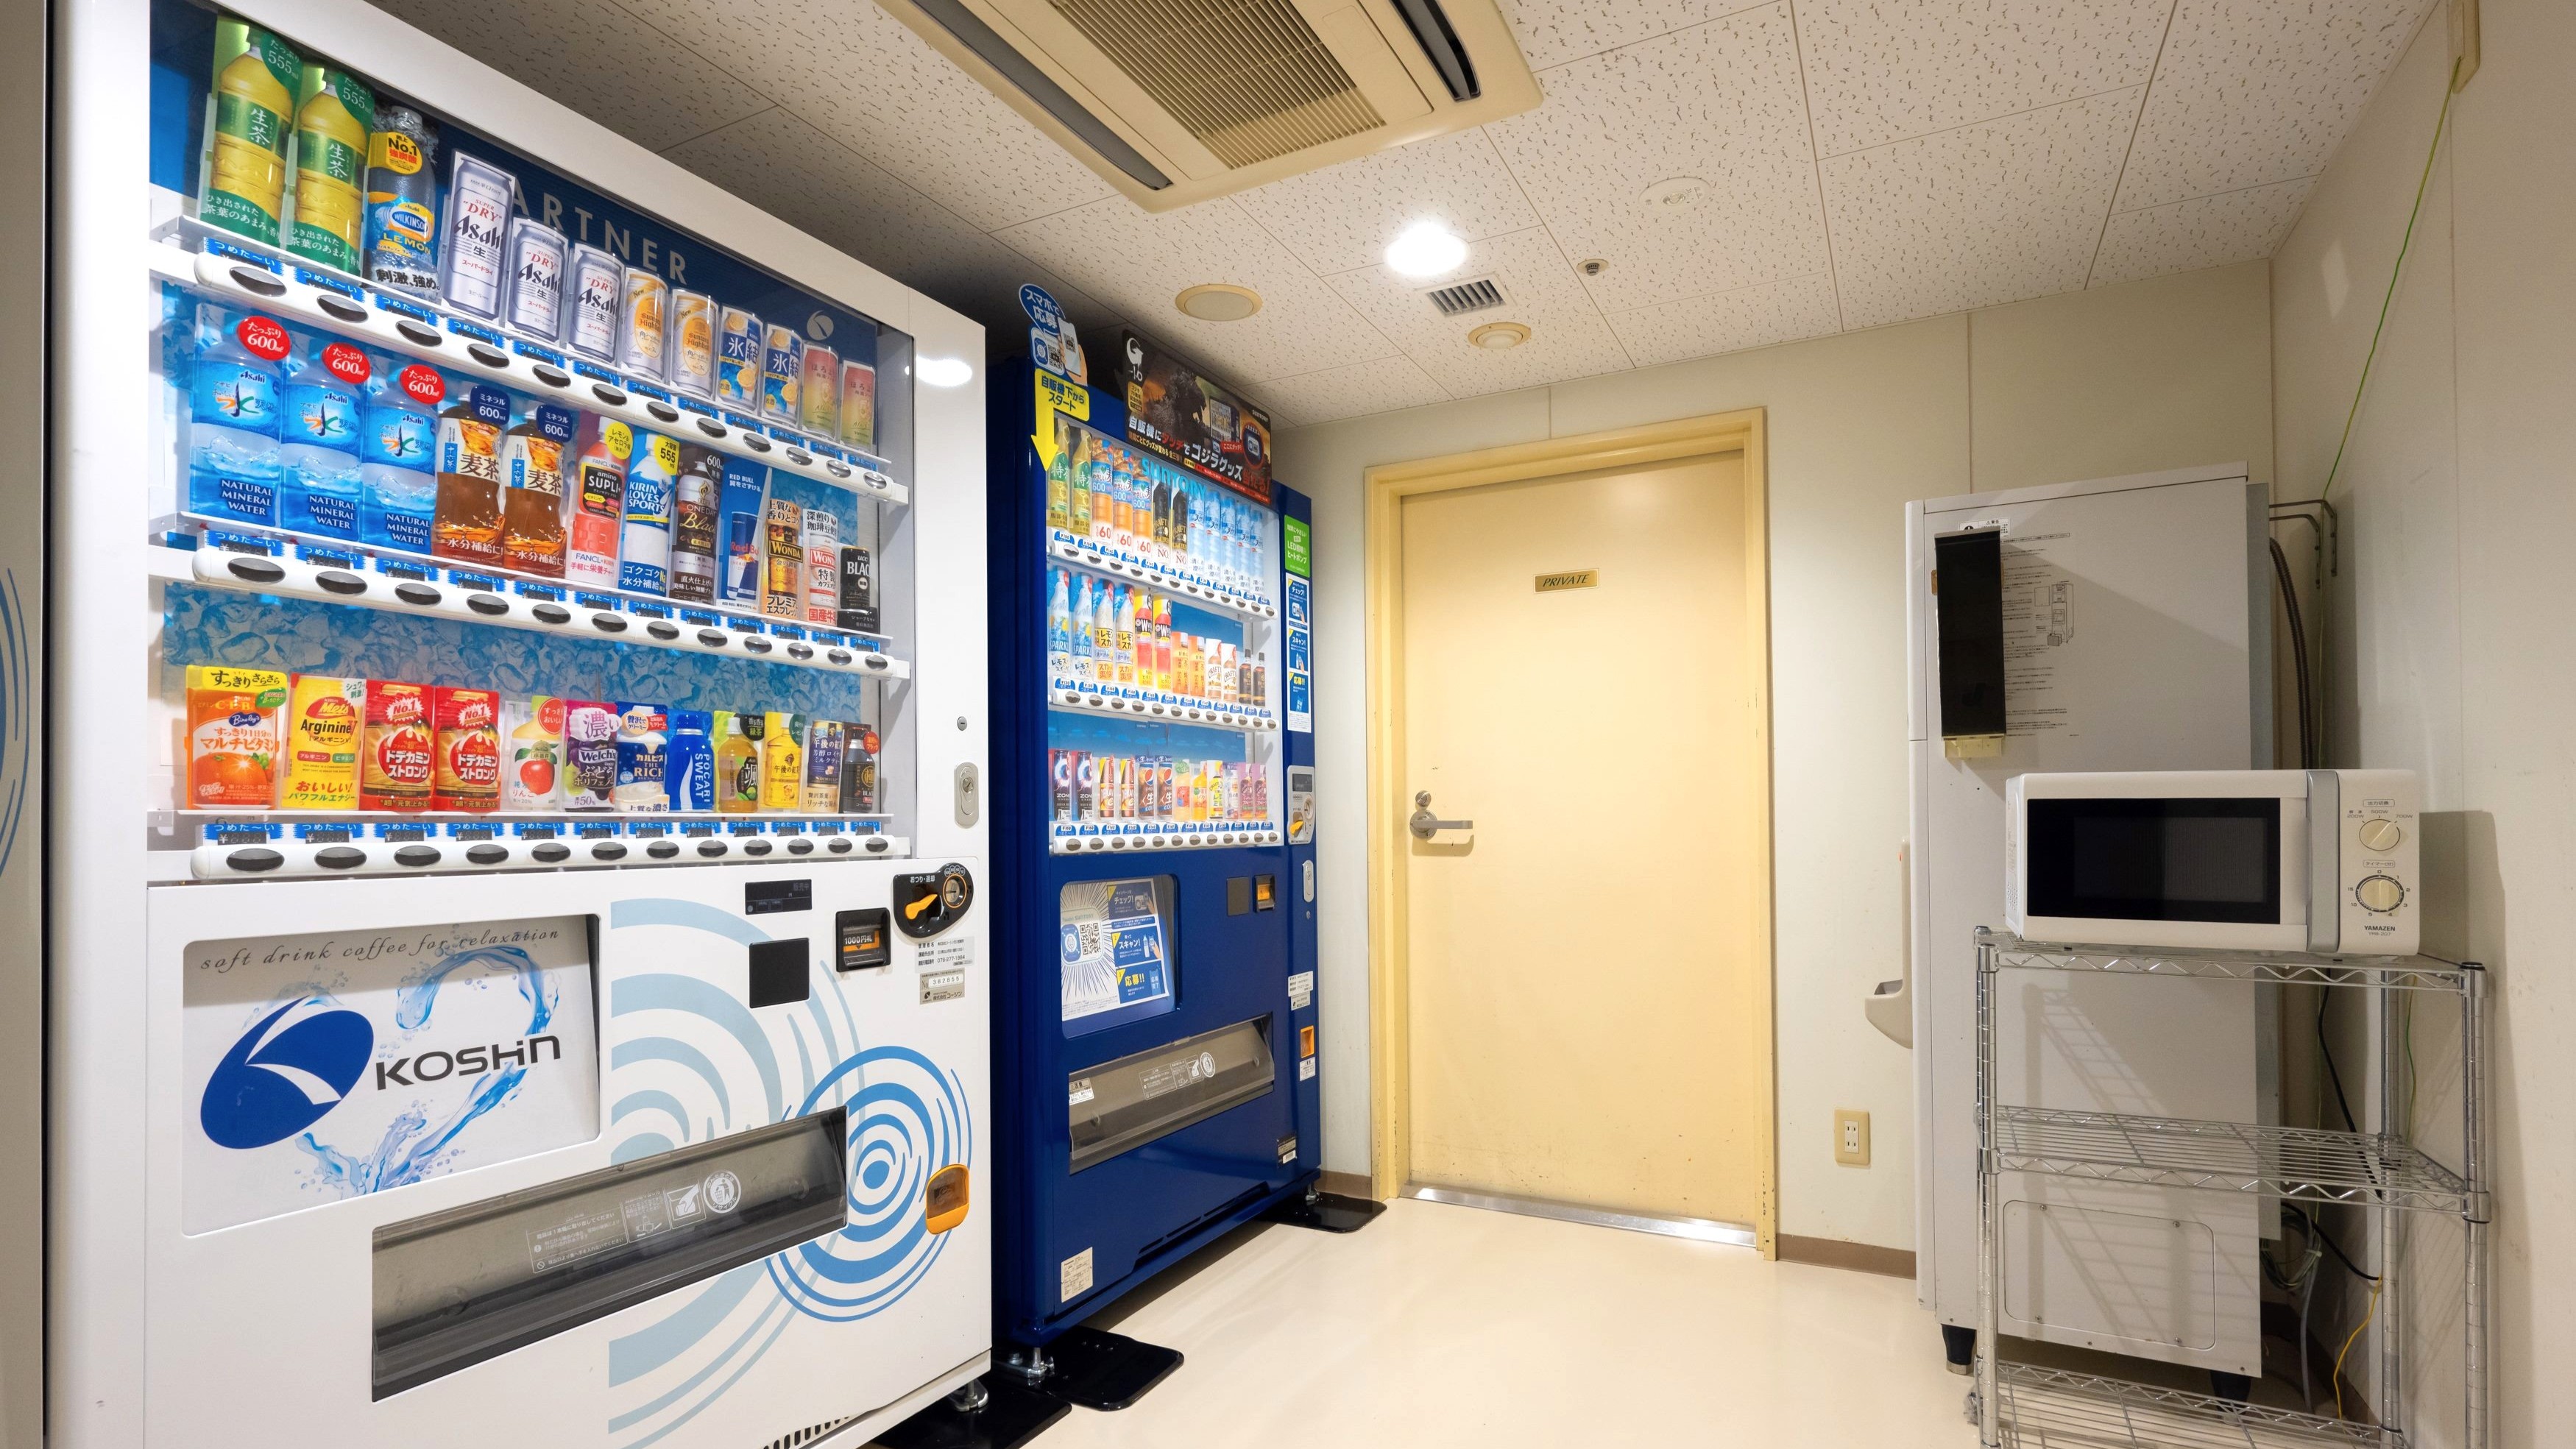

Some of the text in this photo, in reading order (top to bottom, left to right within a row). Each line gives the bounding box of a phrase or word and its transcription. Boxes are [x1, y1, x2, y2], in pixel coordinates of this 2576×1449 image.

[388, 137, 418, 157] No.1
[453, 215, 505, 252] Asahi
[383, 232, 432, 255] LEMON
[517, 263, 562, 296] Asahi
[578, 288, 619, 316] Asahi
[247, 320, 283, 339] たっぷり
[332, 346, 364, 364] たっぷり
[240, 370, 266, 383] Asahi
[407, 369, 439, 385] たっぷり
[325, 392, 348, 405] Asahi
[479, 392, 507, 406] ミネラル
[1048, 391, 1077, 412] スタート
[402, 414, 425, 426] Asahi
[478, 404, 506, 422] 600ml
[545, 411, 570, 425] ミネラル
[544, 422, 570, 439] 600ml
[659, 447, 676, 464] 555
[459, 451, 501, 481] 麦茶
[526, 468, 565, 496] 麦茶
[597, 470, 618, 481] amino
[729, 473, 754, 484] RED BULL
[1141, 457, 1207, 498] SUNTORY
[221, 478, 273, 497] NATURAL
[629, 481, 659, 495] KIRIN
[1092, 481, 1106, 492] 600
[221, 489, 272, 508] MINERAL
[308, 495, 356, 511] NATURAL
[629, 490, 659, 504] LOVES
[1114, 490, 1127, 501] 600
[1133, 498, 1146, 509] 600
[227, 501, 267, 517] WATER
[309, 505, 355, 521] MINERAL
[628, 497, 665, 514] SPORTS
[315, 515, 352, 531] WATER
[385, 512, 431, 528] NATURAL
[807, 511, 829, 523] 深煎り
[386, 522, 430, 537] MINERAL
[391, 531, 425, 546] WATER
[1542, 573, 1590, 587] PRIVATE
[393, 699, 417, 715] No.1
[464, 706, 487, 720] No.1
[300, 719, 352, 735] Arginine
[583, 710, 620, 739] 濃い
[386, 749, 431, 765] ドデカミン
[457, 754, 498, 768] ドデカミン
[580, 750, 617, 762] Welch's
[387, 764, 430, 779] ストロング
[459, 767, 497, 782] ストロング
[694, 752, 704, 798] SWEAT
[702, 753, 711, 804] POCARI
[295, 780, 353, 794] おいしい!
[288, 792, 357, 803] パワフルエナジー
[1114, 895, 1134, 905] チェック!
[844, 934, 874, 946] 1000円札
[1119, 938, 1141, 950] スキャン!
[199, 927, 560, 974] soft drink coffee for relaxation
